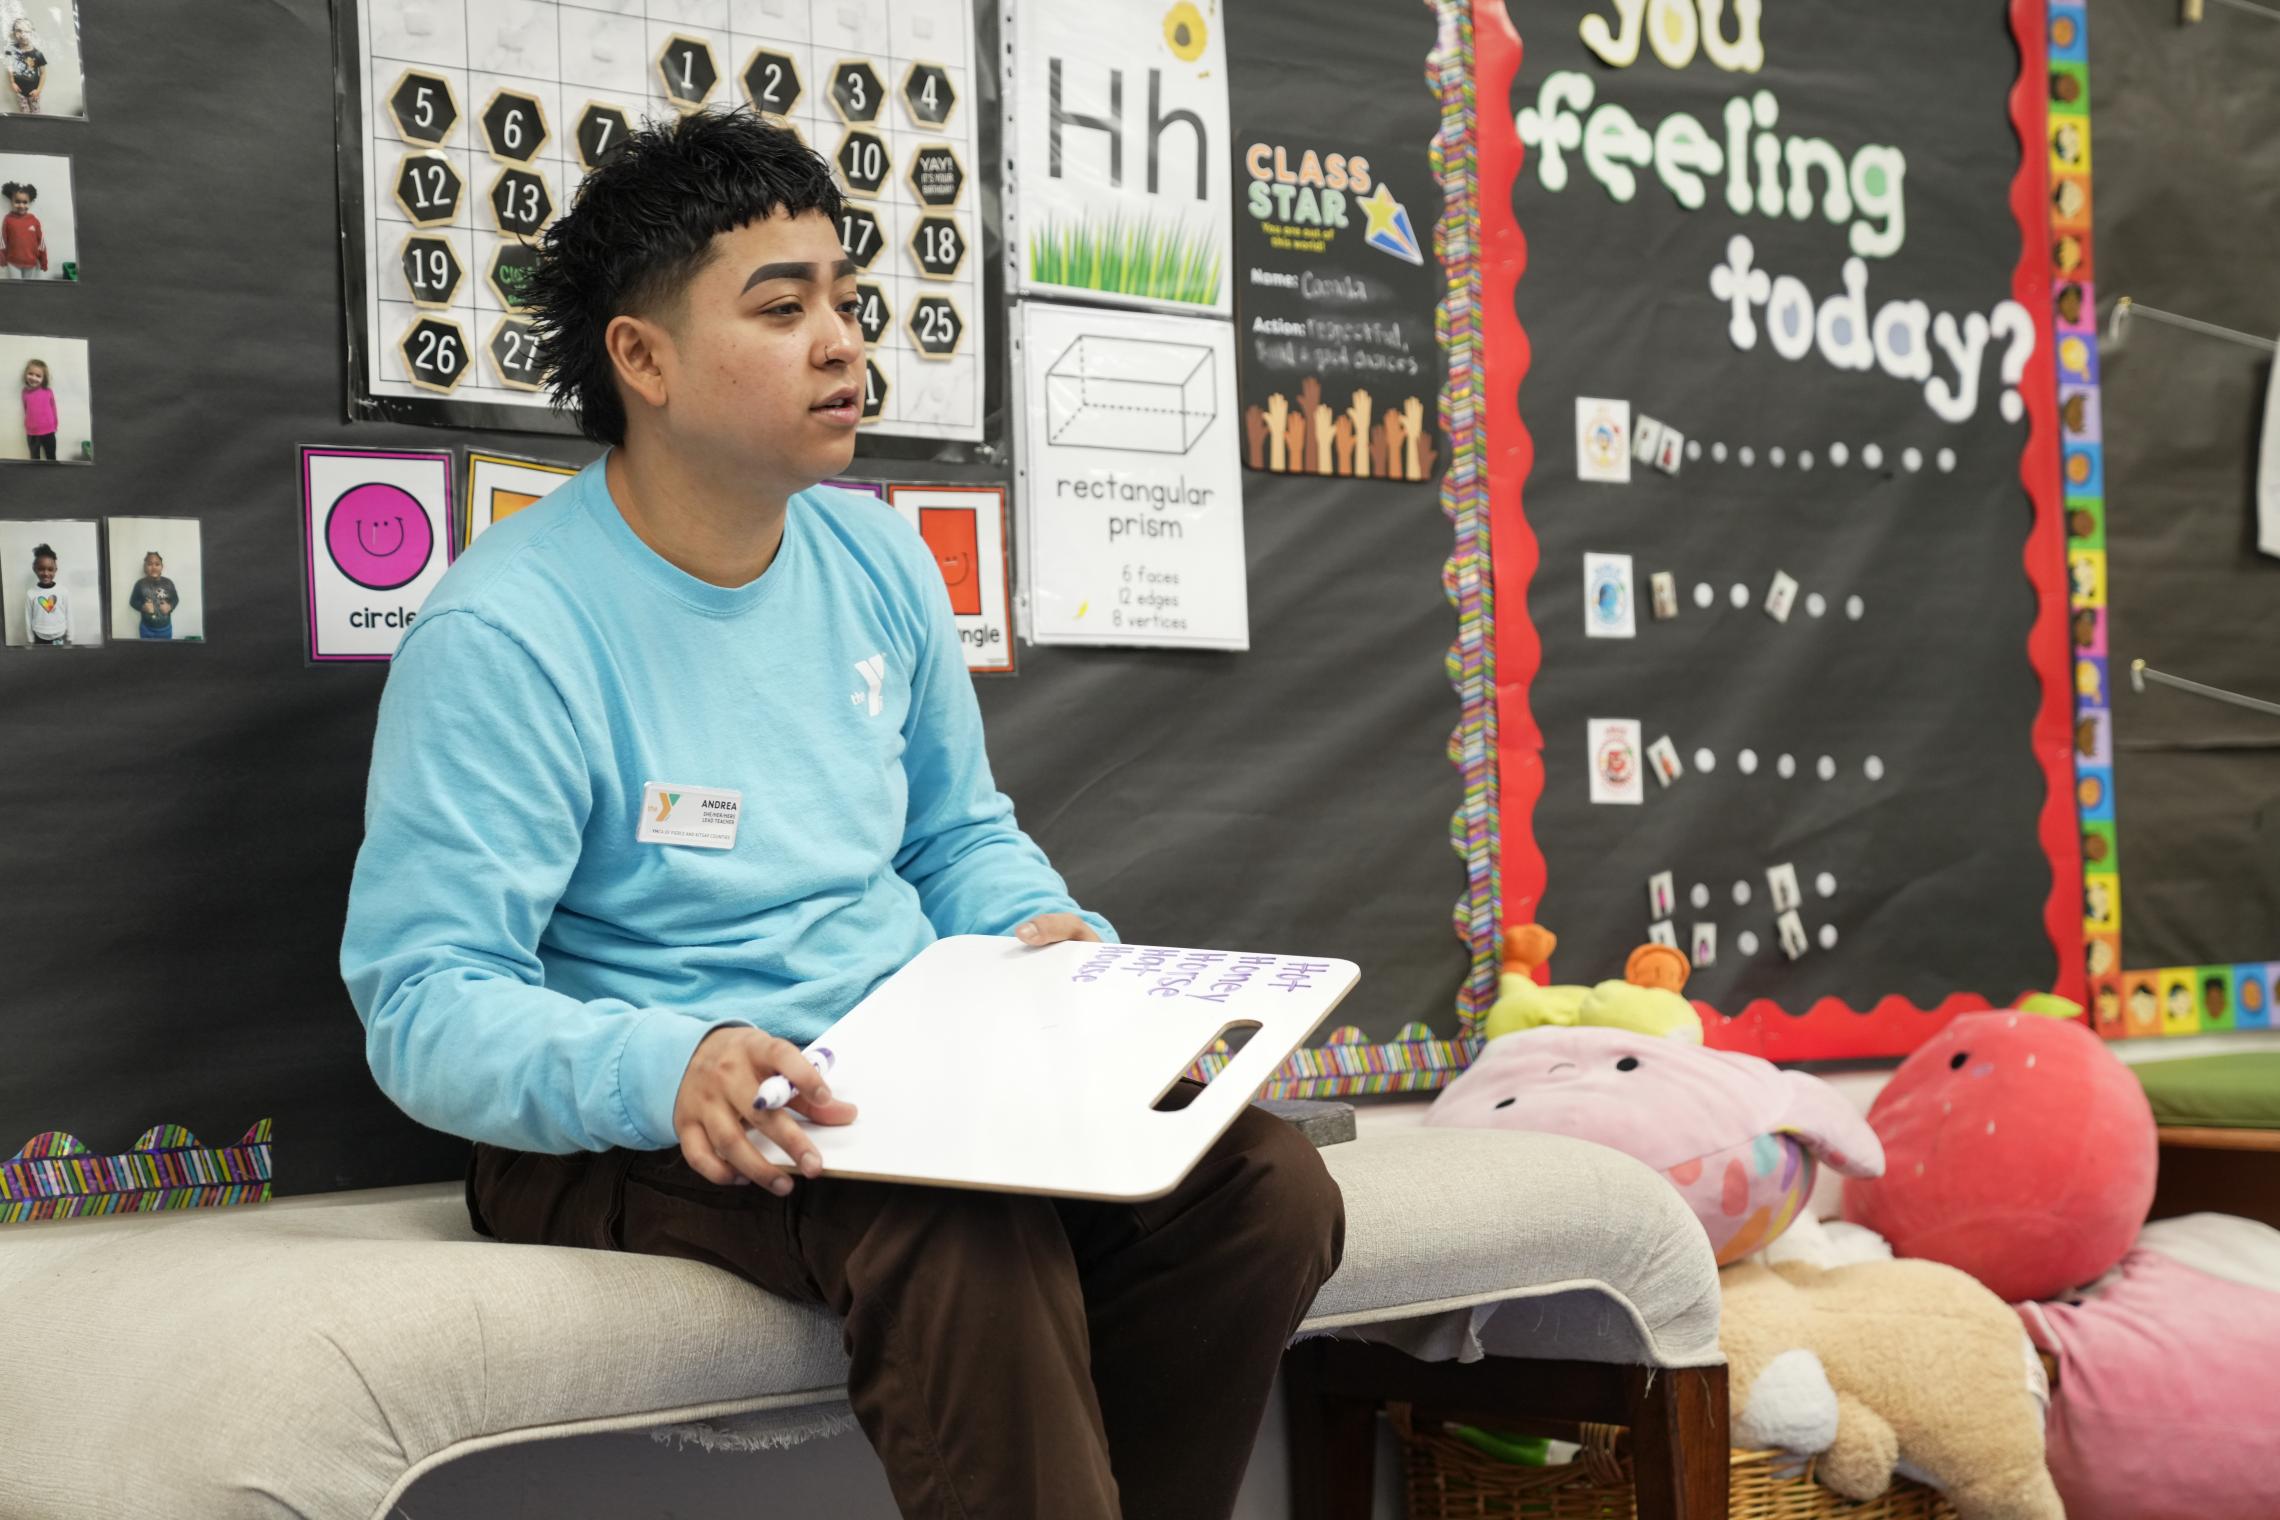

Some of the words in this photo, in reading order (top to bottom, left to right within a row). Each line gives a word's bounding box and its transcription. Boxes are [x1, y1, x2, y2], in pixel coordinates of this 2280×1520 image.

[1579, 0, 1764, 73] you
[681, 50, 694, 90] 1
[763, 63, 782, 103] 2
[847, 73, 866, 111] 3
[920, 74, 939, 111] 4
[414, 87, 434, 128] 5
[503, 109, 523, 149] 6
[596, 116, 614, 156] 7
[848, 140, 882, 181] 10
[920, 156, 954, 171] YAY!
[1246, 143, 1371, 194] CLASS
[1516, 70, 1906, 257] feeling
[409, 165, 451, 208] 12
[502, 179, 540, 222] 13
[842, 216, 875, 256] 17
[924, 225, 956, 264] 18
[1248, 181, 1349, 228] STAR
[411, 248, 449, 290] 19
[1250, 267, 1299, 289] Name:
[919, 305, 954, 345] 25
[1252, 315, 1306, 337] Action:
[1710, 234, 2036, 422] today?
[415, 330, 457, 374] 26
[502, 330, 540, 371] 27
[1057, 473, 1214, 511] rectangular
[1109, 512, 1183, 542] prism
[1122, 564, 1132, 582] 6
[1138, 564, 1180, 584] faces
[1119, 586, 1132, 605] 12
[1137, 589, 1179, 610] edges
[1112, 609, 1123, 627] 8
[1129, 613, 1187, 630] vertices
[701, 800, 737, 811] ANDREA
[1147, 953, 1228, 997] Horse
[1267, 963, 1330, 993] Hot
